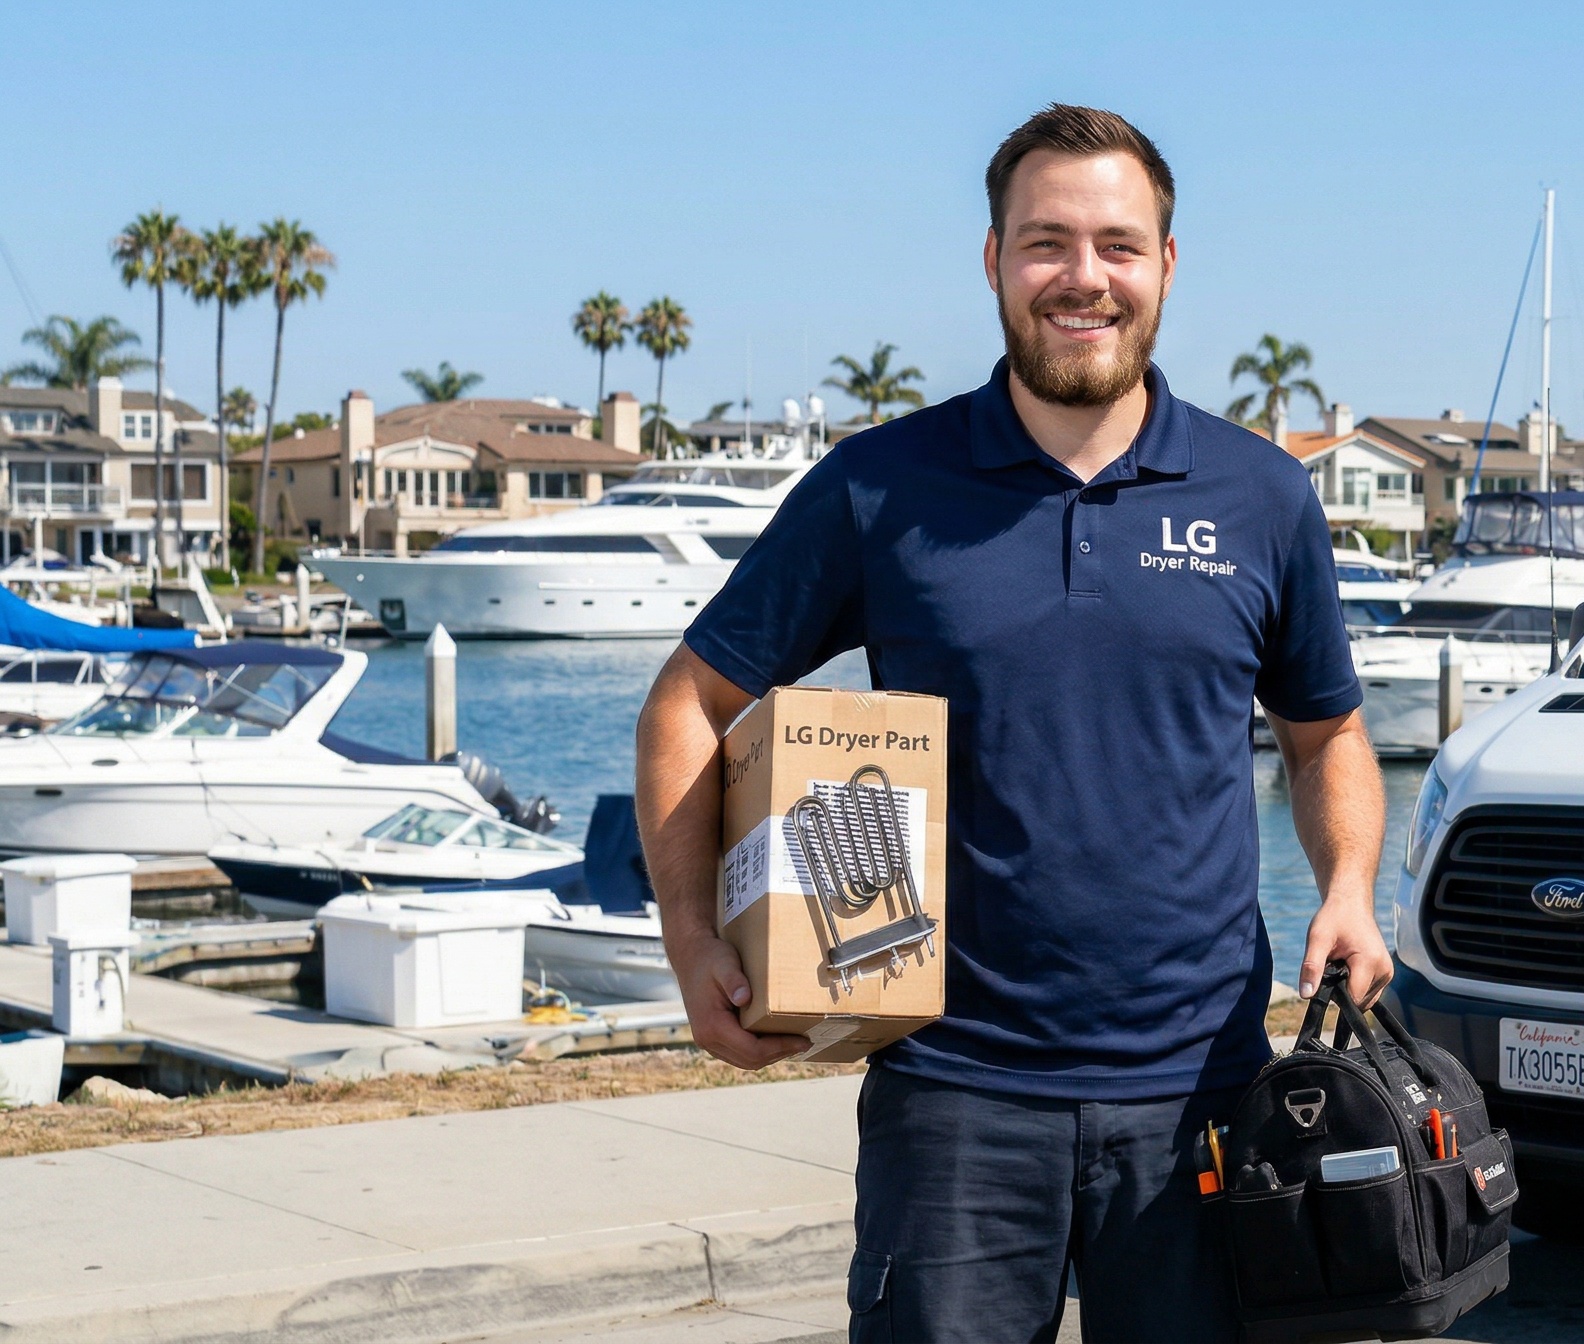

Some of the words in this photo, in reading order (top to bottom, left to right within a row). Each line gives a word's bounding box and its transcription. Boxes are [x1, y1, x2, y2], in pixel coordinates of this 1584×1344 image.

[1161, 517, 1217, 555] LG
[1140, 552, 1185, 572] Dryer
[1189, 556, 1237, 577] Repair
[785, 725, 813, 745] LG
[819, 727, 880, 752] Dryer
[885, 731, 930, 752] Part
[1519, 1024, 1580, 1047] California
